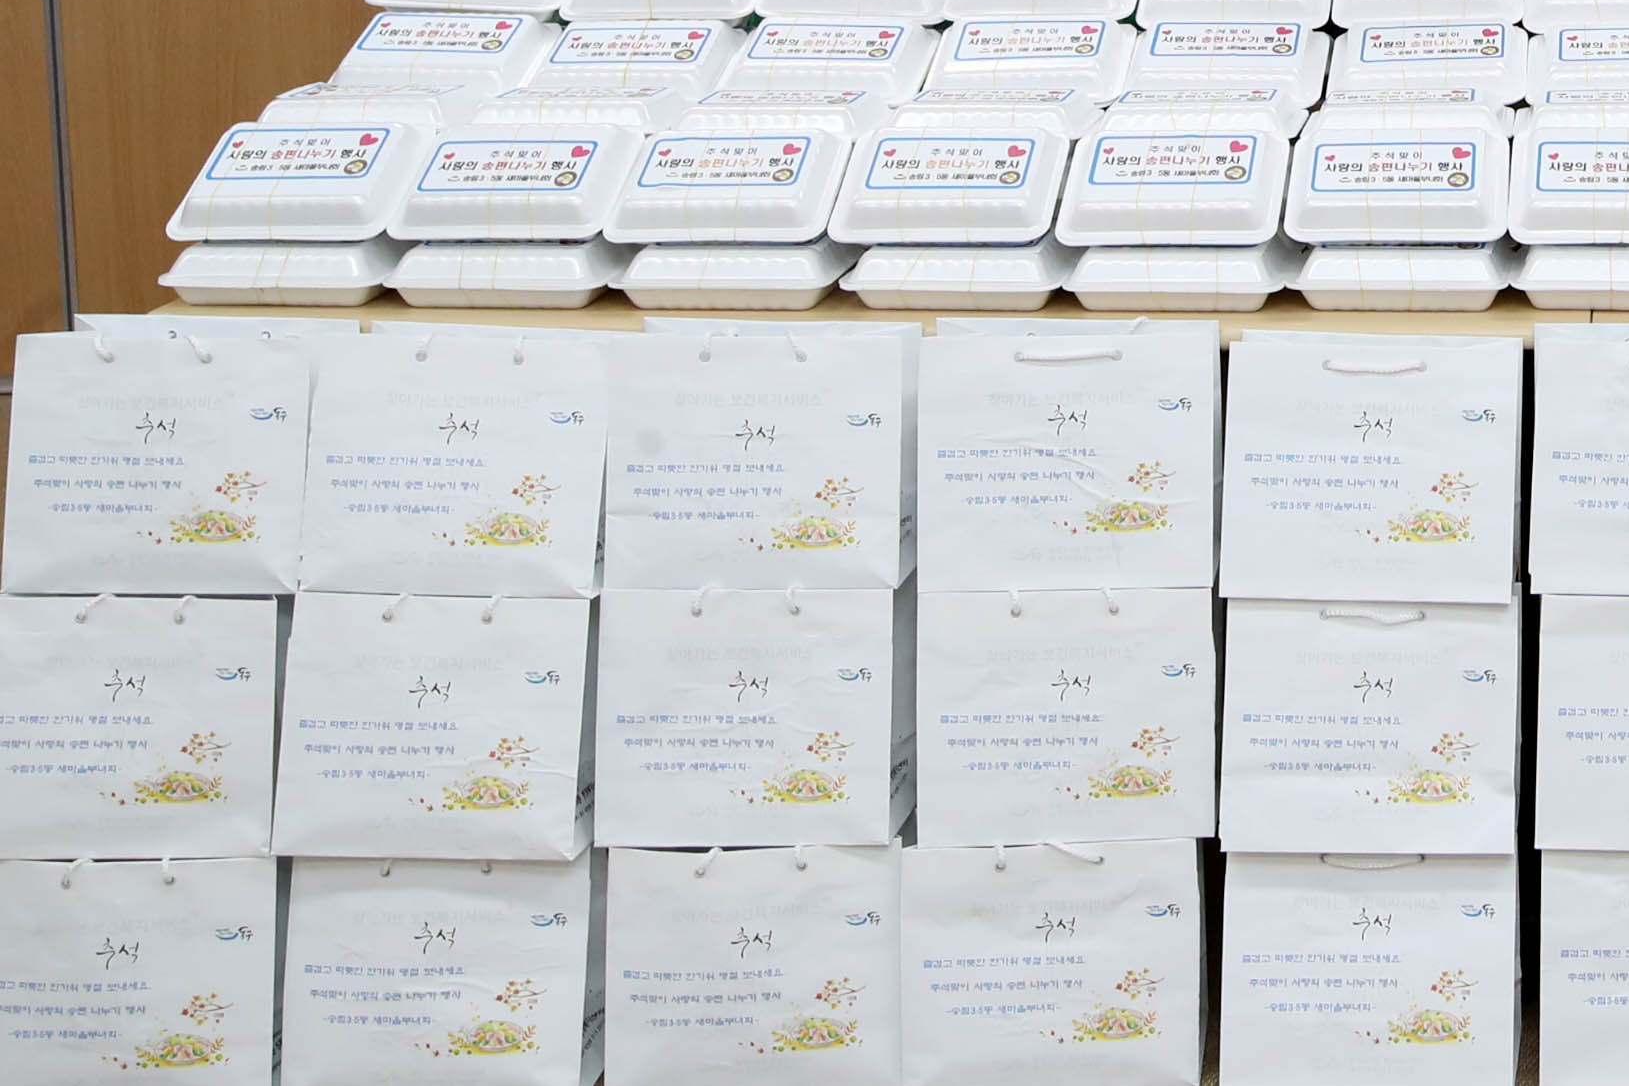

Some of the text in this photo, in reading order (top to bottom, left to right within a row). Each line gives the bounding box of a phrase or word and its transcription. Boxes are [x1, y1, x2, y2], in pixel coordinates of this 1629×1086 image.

[226, 149, 268, 159] 사랑의
[338, 148, 368, 158] 행사
[655, 157, 696, 167] 사랑의
[766, 157, 793, 166] 행사
[881, 158, 922, 168] 사랑의
[992, 159, 1018, 169] 행사
[1102, 156, 1141, 165] 사랑의
[1214, 155, 1241, 164] 행사
[437, 161, 479, 170] 사랑의
[548, 161, 578, 170] 행사
[1324, 162, 1363, 172] 사랑의
[1437, 162, 1462, 171] 행사
[1548, 161, 1586, 171] 사랑의
